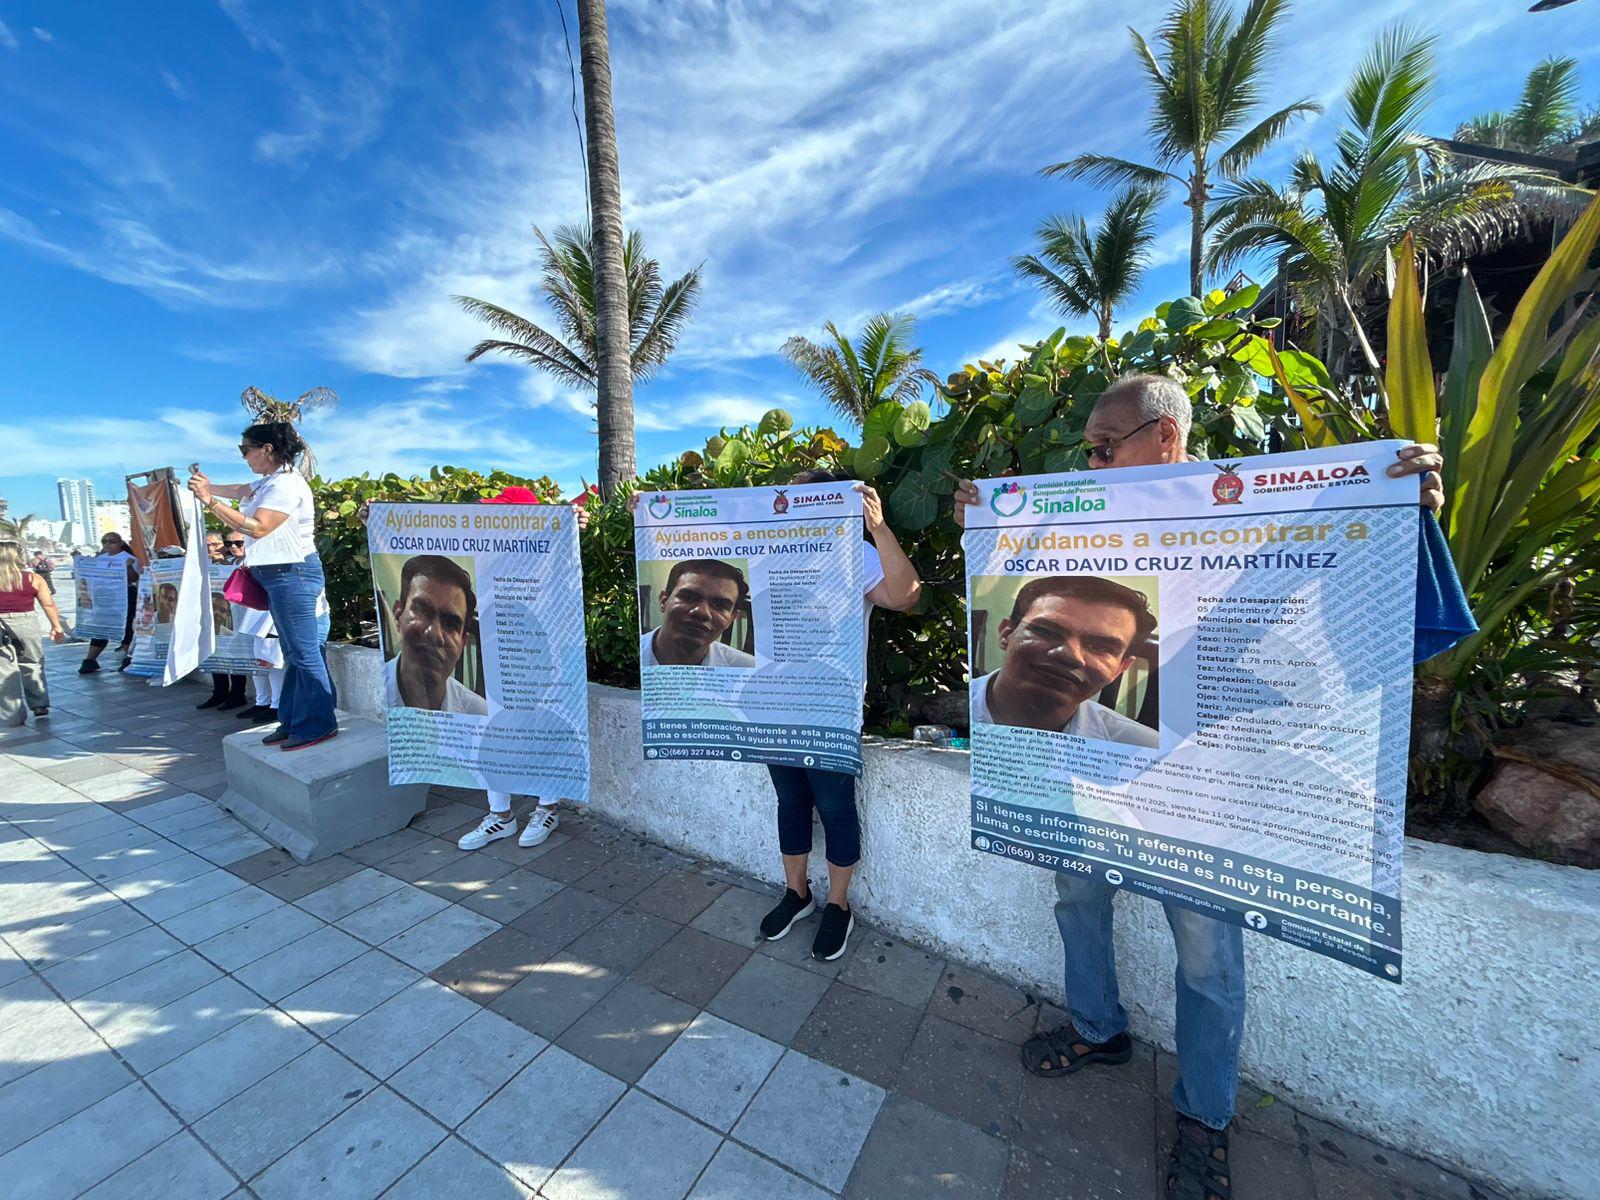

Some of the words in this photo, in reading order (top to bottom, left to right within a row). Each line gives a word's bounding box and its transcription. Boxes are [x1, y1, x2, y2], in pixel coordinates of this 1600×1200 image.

[1254, 465, 1369, 486] SINALOA
[1254, 485, 1303, 494] GOBIERNO
[1329, 478, 1370, 488] ESTADO
[793, 493, 843, 504] SINALOA
[1032, 496, 1105, 514] Sinaloa
[675, 506, 717, 518] Sinaloa
[386, 509, 456, 532] Ayúdanos
[462, 516, 470, 528] a
[474, 514, 546, 530] encontrar
[552, 516, 560, 530] a
[656, 528, 727, 546] Ayúdanos
[734, 532, 742, 540] a
[747, 526, 829, 539] encontrar
[836, 526, 845, 535] a
[998, 529, 1122, 557] Ayúdanos
[1134, 532, 1149, 547] a
[1160, 522, 1334, 546] encontrar
[1346, 521, 1368, 540] a
[390, 537, 424, 550] OSCAR
[427, 538, 459, 551] DAVID
[463, 538, 490, 552] CRUZ
[494, 536, 550, 553] MARTÍNEZ
[660, 548, 694, 557] OSCAR
[698, 547, 732, 556] DAVID
[735, 546, 765, 555] CRUZ
[769, 542, 832, 554] MARTÍNEZ
[1004, 558, 1059, 572] OSCAR
[1066, 558, 1128, 571] DAVID
[1135, 556, 1192, 570] CRUZ
[1202, 549, 1337, 570] MARTÍNEZ
[1240, 597, 1308, 605] Desaparición:
[1218, 606, 1270, 615] Septiembre
[1198, 616, 1242, 625] Municipio
[1217, 666, 1254, 674] Moreno
[1288, 660, 1320, 668] Aprox.
[1197, 674, 1255, 685] Complexión:
[1257, 679, 1296, 687] Delgada
[1197, 683, 1220, 692] Cara:
[1222, 686, 1259, 695] Ovalada
[1197, 693, 1220, 702] Ojos:
[1222, 695, 1270, 706] Medianos,
[1273, 698, 1293, 707] café
[1296, 702, 1331, 710] oscuro
[1197, 702, 1222, 710] Nariz:
[1225, 705, 1253, 714] Ancha
[692, 722, 742, 732] información
[1197, 712, 1233, 721] Cabello:
[1236, 716, 1284, 727] Ondulado,
[1287, 720, 1327, 730] castaño
[1330, 726, 1366, 736] oscuro
[1197, 721, 1229, 730] Frente:
[1232, 725, 1272, 735] Mediana
[682, 732, 732, 740] escribenos.
[748, 736, 774, 744] ayuda
[791, 738, 810, 747] muy
[1197, 731, 1221, 739] Boca:
[1224, 734, 1260, 744] Grande,
[1262, 738, 1291, 747] labios
[1293, 742, 1334, 753] gruesos
[1197, 740, 1222, 750] Cejas:
[1225, 743, 1266, 754] Pobladas
[976, 800, 988, 812] Si
[994, 805, 1033, 823] tienes
[1040, 814, 1130, 842] información
[1138, 836, 1214, 863] referente
[1224, 858, 1233, 869] a
[1243, 863, 1285, 884] esta
[1296, 878, 1392, 920] persona,
[1007, 844, 1035, 862] (669)
[1038, 853, 1059, 866] 327
[1063, 858, 1093, 874] 8424
[976, 813, 1009, 830] llama
[1012, 824, 1021, 833] o
[1024, 826, 1110, 852] escribenos.
[1115, 844, 1133, 858] Tu
[1138, 851, 1189, 872] ayuda
[1194, 866, 1214, 880] es
[1220, 874, 1260, 896] muy
[1266, 886, 1392, 937] importante.
[1282, 919, 1320, 936] Comisión
[1322, 932, 1351, 946] Estatal
[1354, 942, 1364, 951] de
